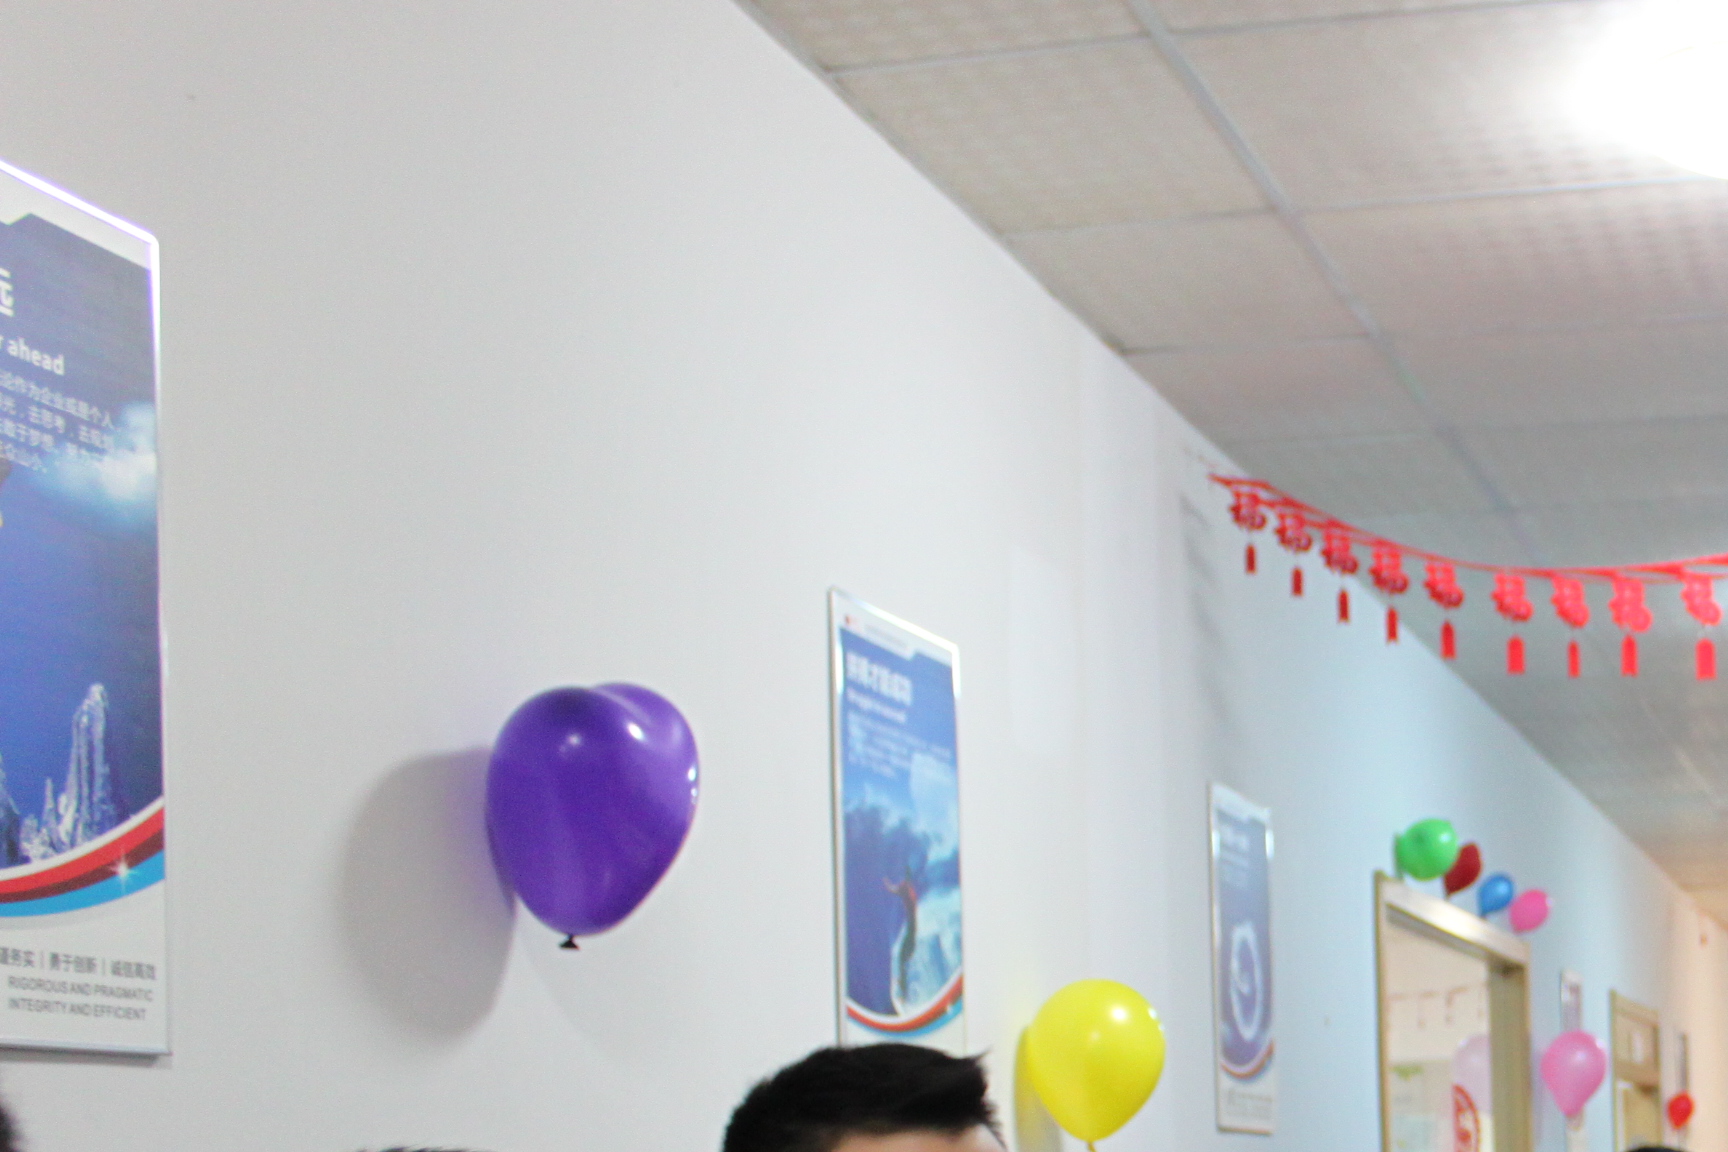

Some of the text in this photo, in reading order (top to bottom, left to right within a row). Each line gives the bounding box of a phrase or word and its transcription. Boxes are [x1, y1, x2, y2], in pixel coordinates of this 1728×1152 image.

[7, 338, 65, 376] ahead
[8, 976, 154, 1002] RIGOROUS AND PRAGMATIC
[8, 998, 147, 1021] INTEGRITY AND EFFICIENT
